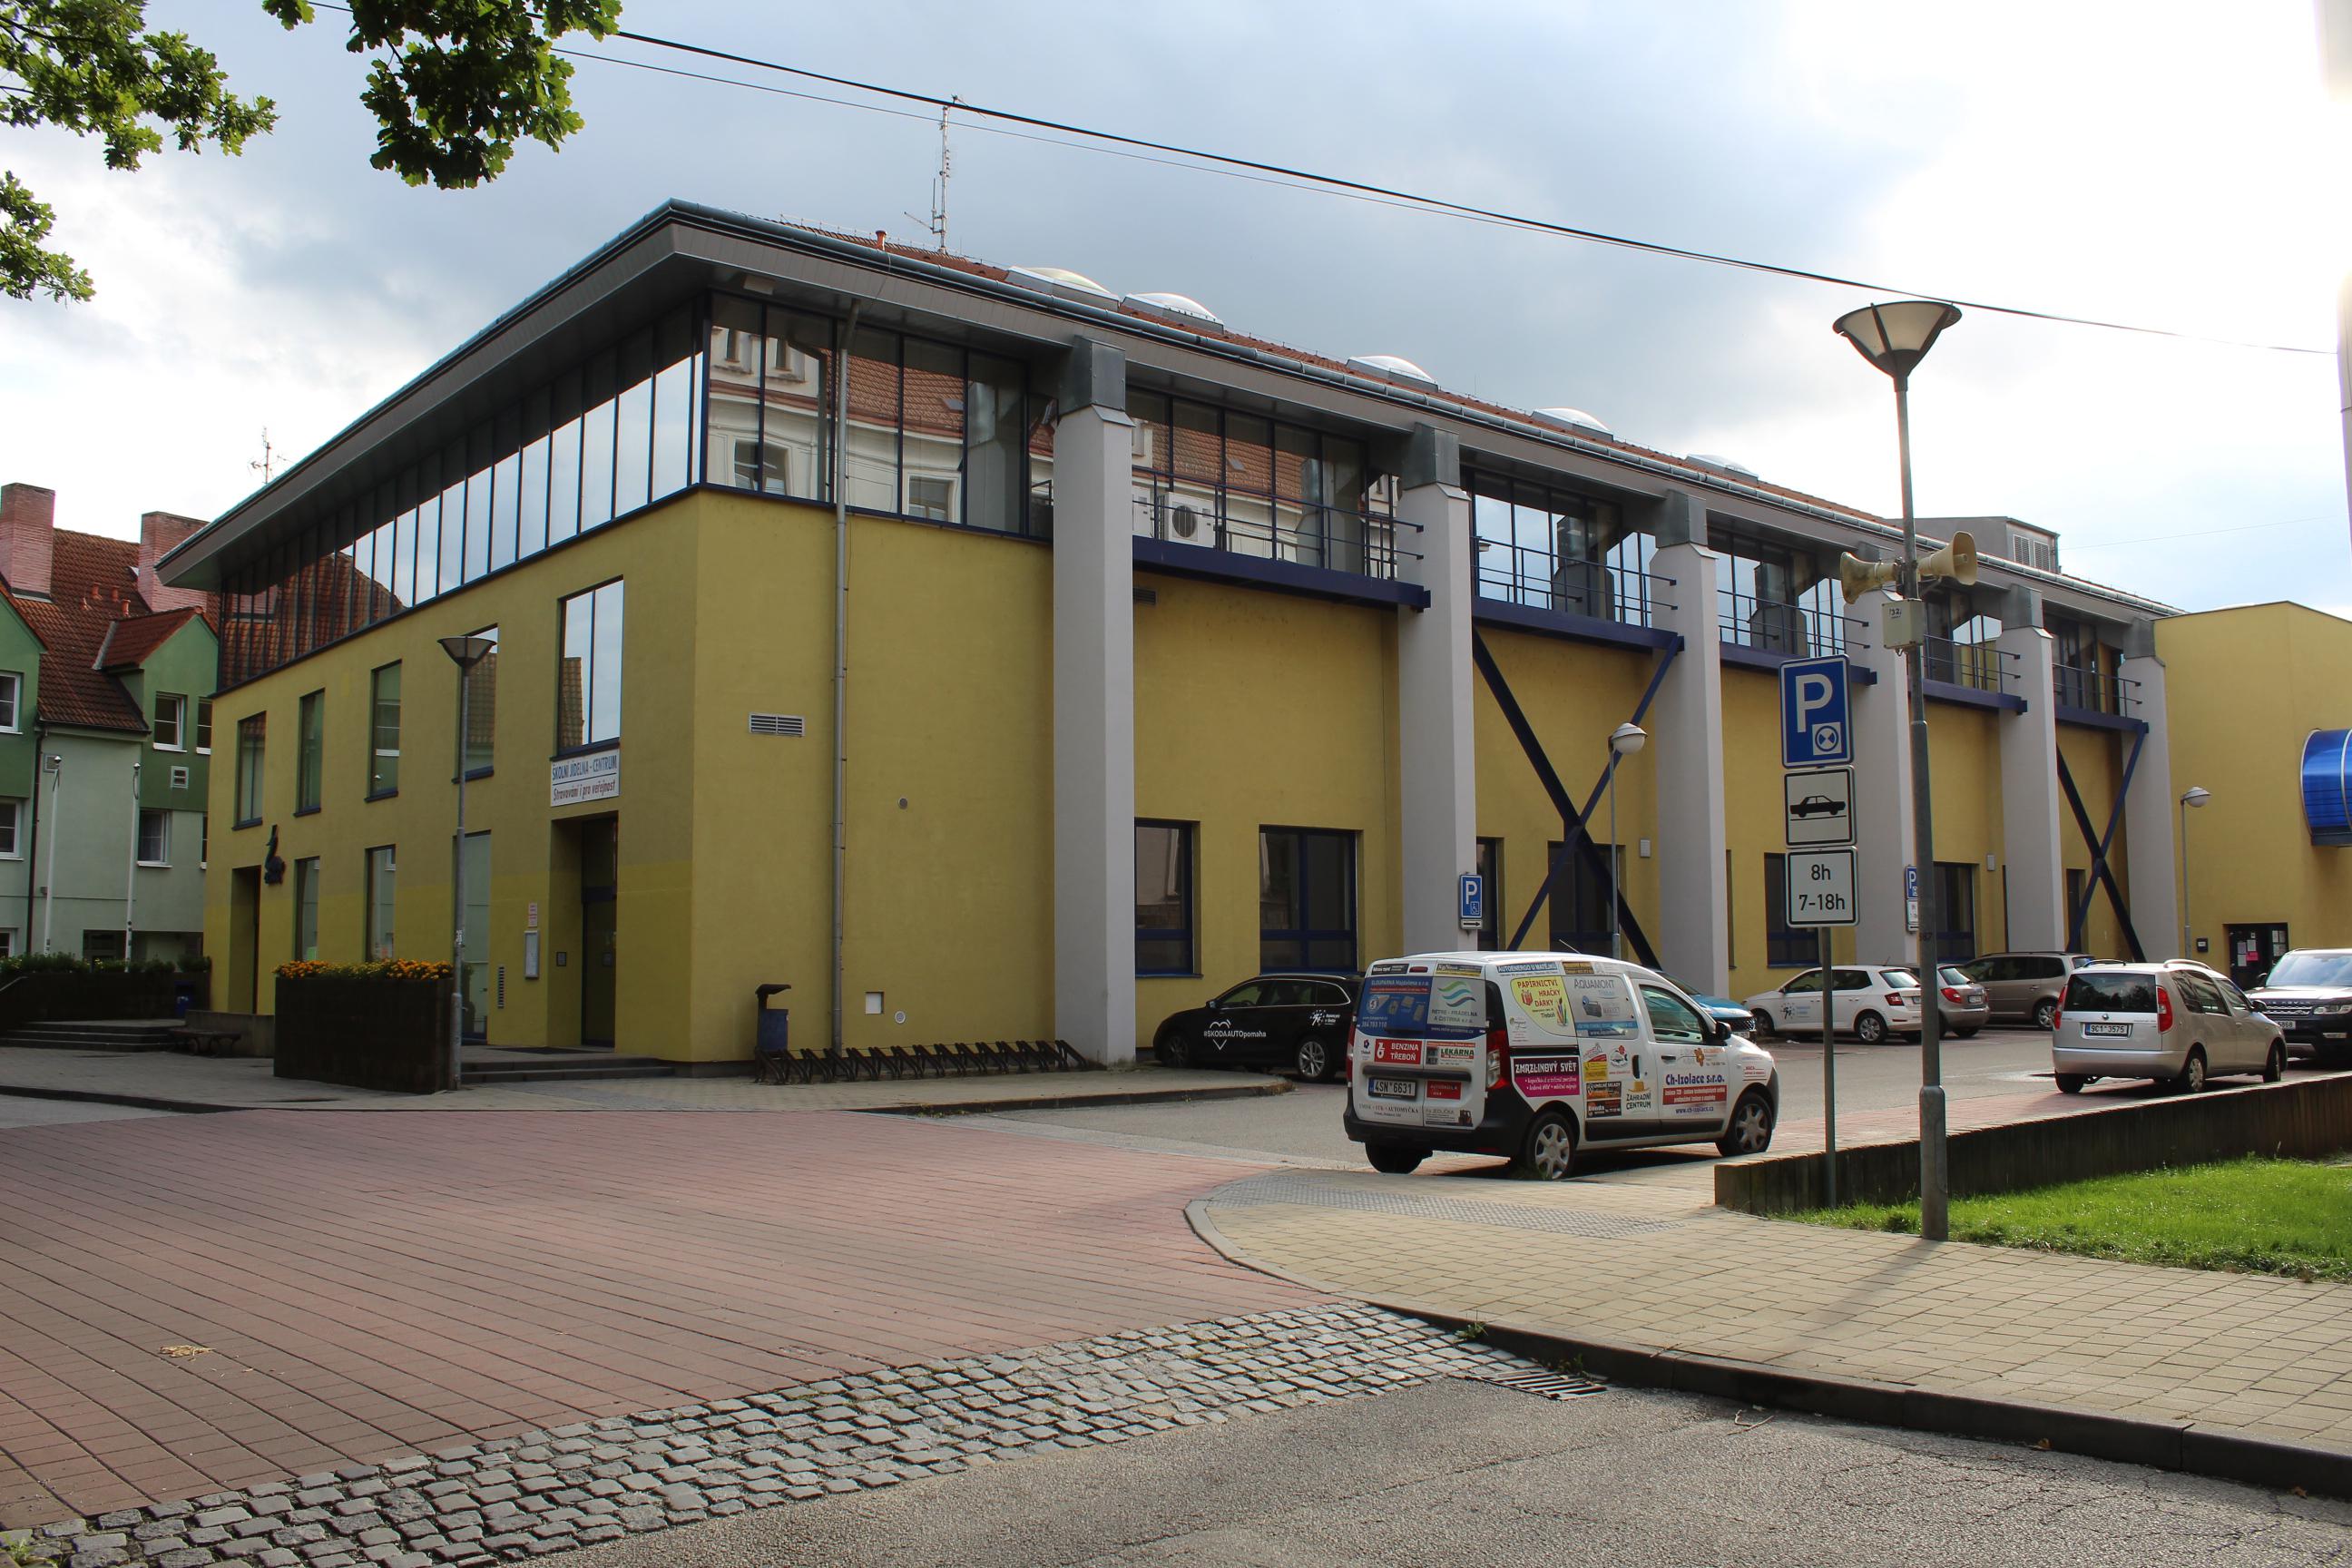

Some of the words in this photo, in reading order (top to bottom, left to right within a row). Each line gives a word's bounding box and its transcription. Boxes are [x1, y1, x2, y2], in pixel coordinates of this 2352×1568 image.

[1796, 673, 1833, 733] P
[553, 762, 569, 780] ŠKOLNÍ
[570, 760, 589, 778] JÍDELNA
[593, 755, 617, 772] CENTRUM
[554, 785, 579, 801] Stravování
[583, 785, 591, 799] pro
[593, 779, 616, 797] veřejnost
[1811, 864, 1831, 880] 8h
[1908, 870, 1916, 889] P
[1465, 880, 1477, 905] P
[1798, 894, 1846, 911] 7-18h
[1517, 979, 1558, 988] PAPÍRNICTVÍ
[1573, 979, 1614, 988] AQUAMONT
[1539, 987, 1560, 996] HRAČKY
[1534, 998, 1553, 1006] DÁRKY
[1391, 1043, 1418, 1051] BENZINA
[1390, 1052, 1416, 1061] TŘEBOŇ
[1515, 1061, 1559, 1073] ZMRZLINOVÝ
[1560, 1060, 1577, 1072] SVĚT
[1665, 1073, 1704, 1085] Ch-Izolace
[1706, 1073, 1725, 1083] s.r.o.
[1376, 1081, 1388, 1093] 4SN
[1393, 1083, 1412, 1094] 6631
[1626, 1091, 1651, 1102] ZAHRADNÍ
[1626, 1101, 1651, 1110] CENTRUM
